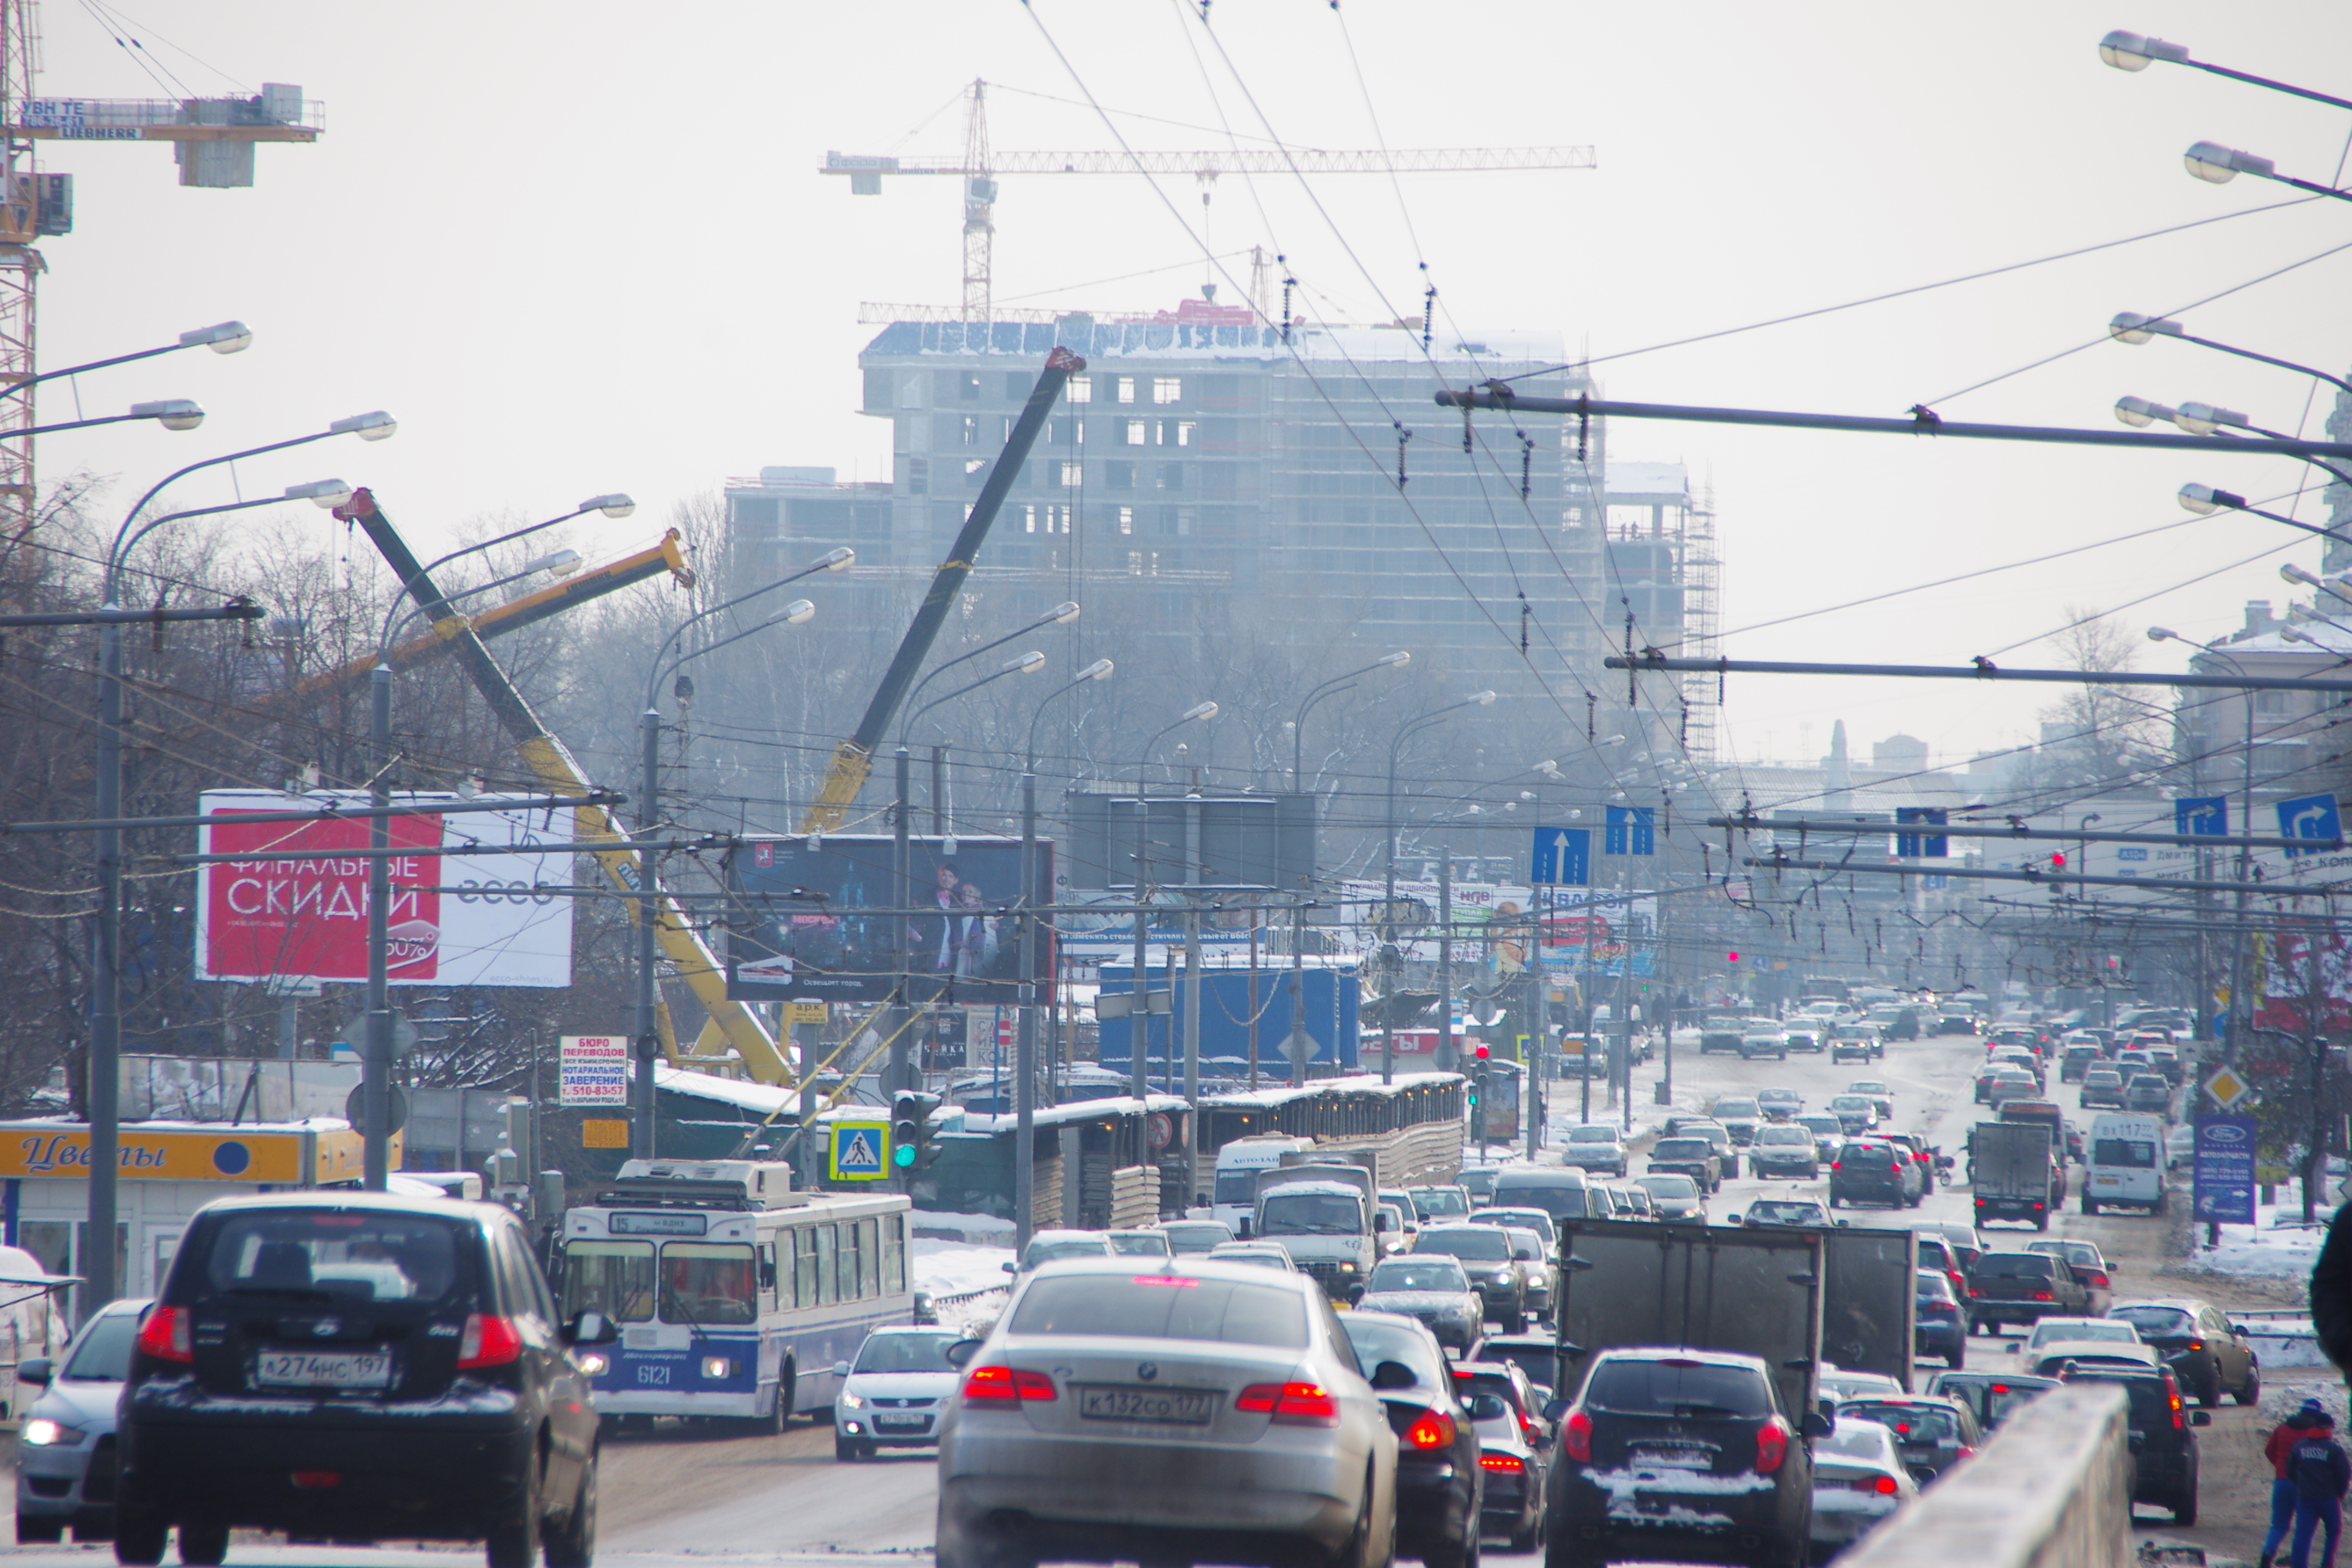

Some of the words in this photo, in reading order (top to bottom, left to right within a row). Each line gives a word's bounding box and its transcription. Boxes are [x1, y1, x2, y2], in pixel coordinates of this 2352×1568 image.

[62, 102, 84, 115] ТЕ
[62, 127, 137, 139] LIEBHERR
[457, 879, 555, 906] ecco
[1395, 884, 1459, 893] НЕДВИЖИМТИ
[804, 979, 840, 987] Освещает
[578, 1038, 610, 1048] БЮРО
[563, 1048, 625, 1057] ПЕРЕВОДОВ
[562, 1066, 625, 1074] НОТАРИАЛЬНОЕ
[563, 1076, 624, 1085] ЗАВЕРЕНИЕ
[573, 1086, 623, 1095] 510-83-57
[22, 1135, 166, 1174] Цвеы
[616, 1217, 628, 1234] 15
[354, 1355, 385, 1375] 197
[637, 1365, 670, 1385] 6121
[1175, 1395, 1205, 1413] 177
[2300, 1447, 2329, 1462] RUSSIA
